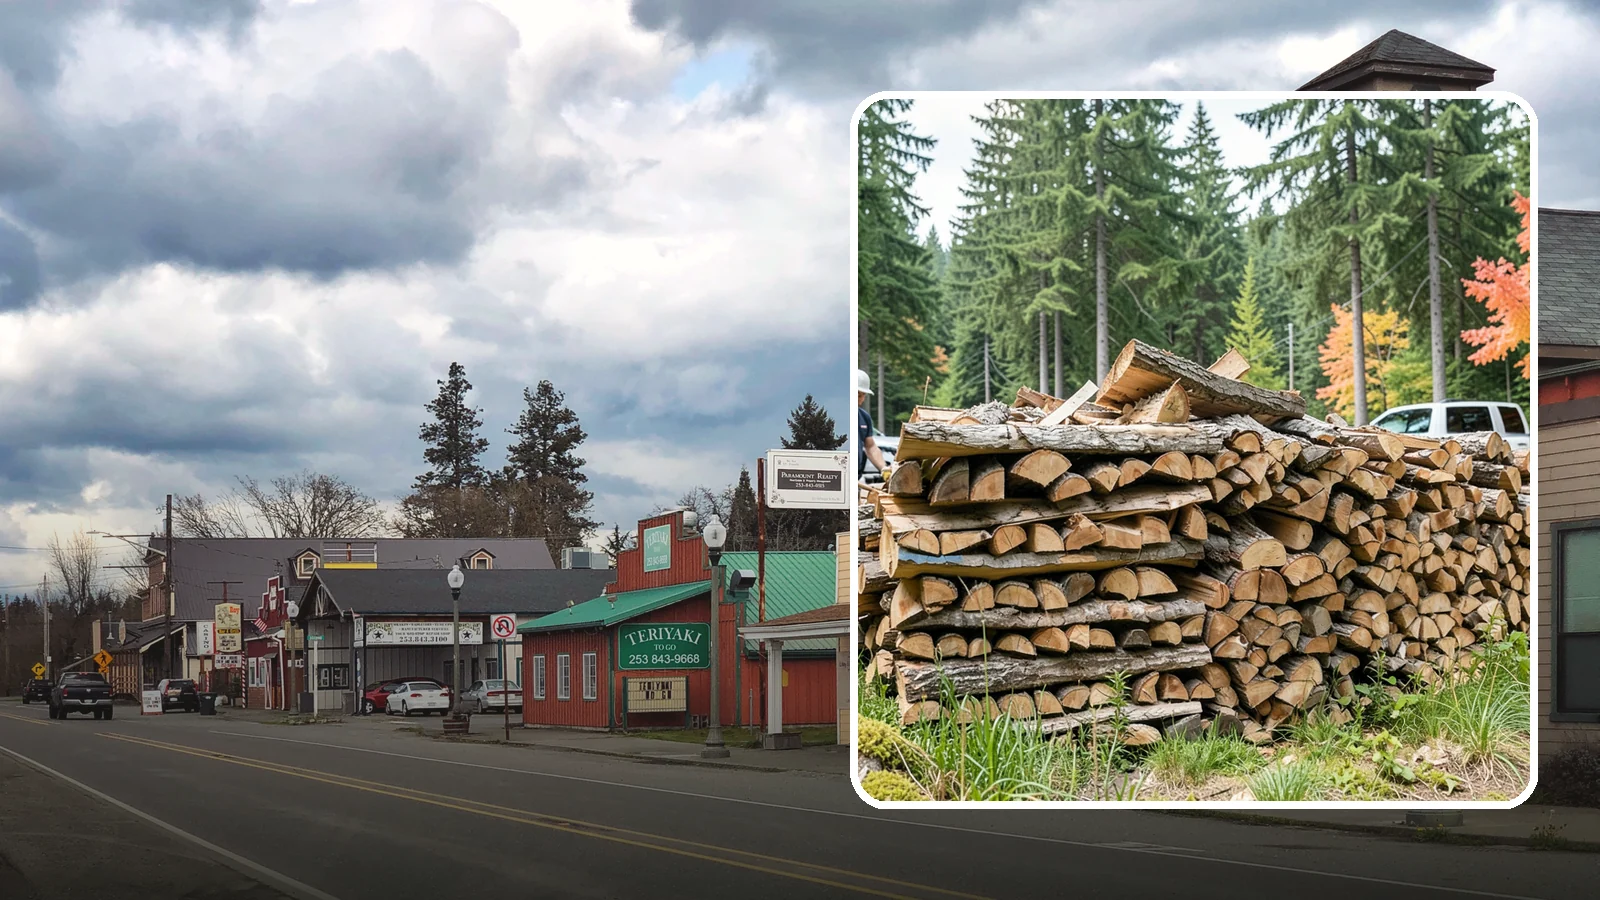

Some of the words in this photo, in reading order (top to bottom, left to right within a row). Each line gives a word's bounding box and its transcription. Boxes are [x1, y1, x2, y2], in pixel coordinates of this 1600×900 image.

[625, 627, 702, 646] TERIYAKI
[654, 645, 664, 653] TO
[665, 645, 676, 653] GO
[629, 656, 648, 666] 253
[651, 655, 700, 666] 843-9668
